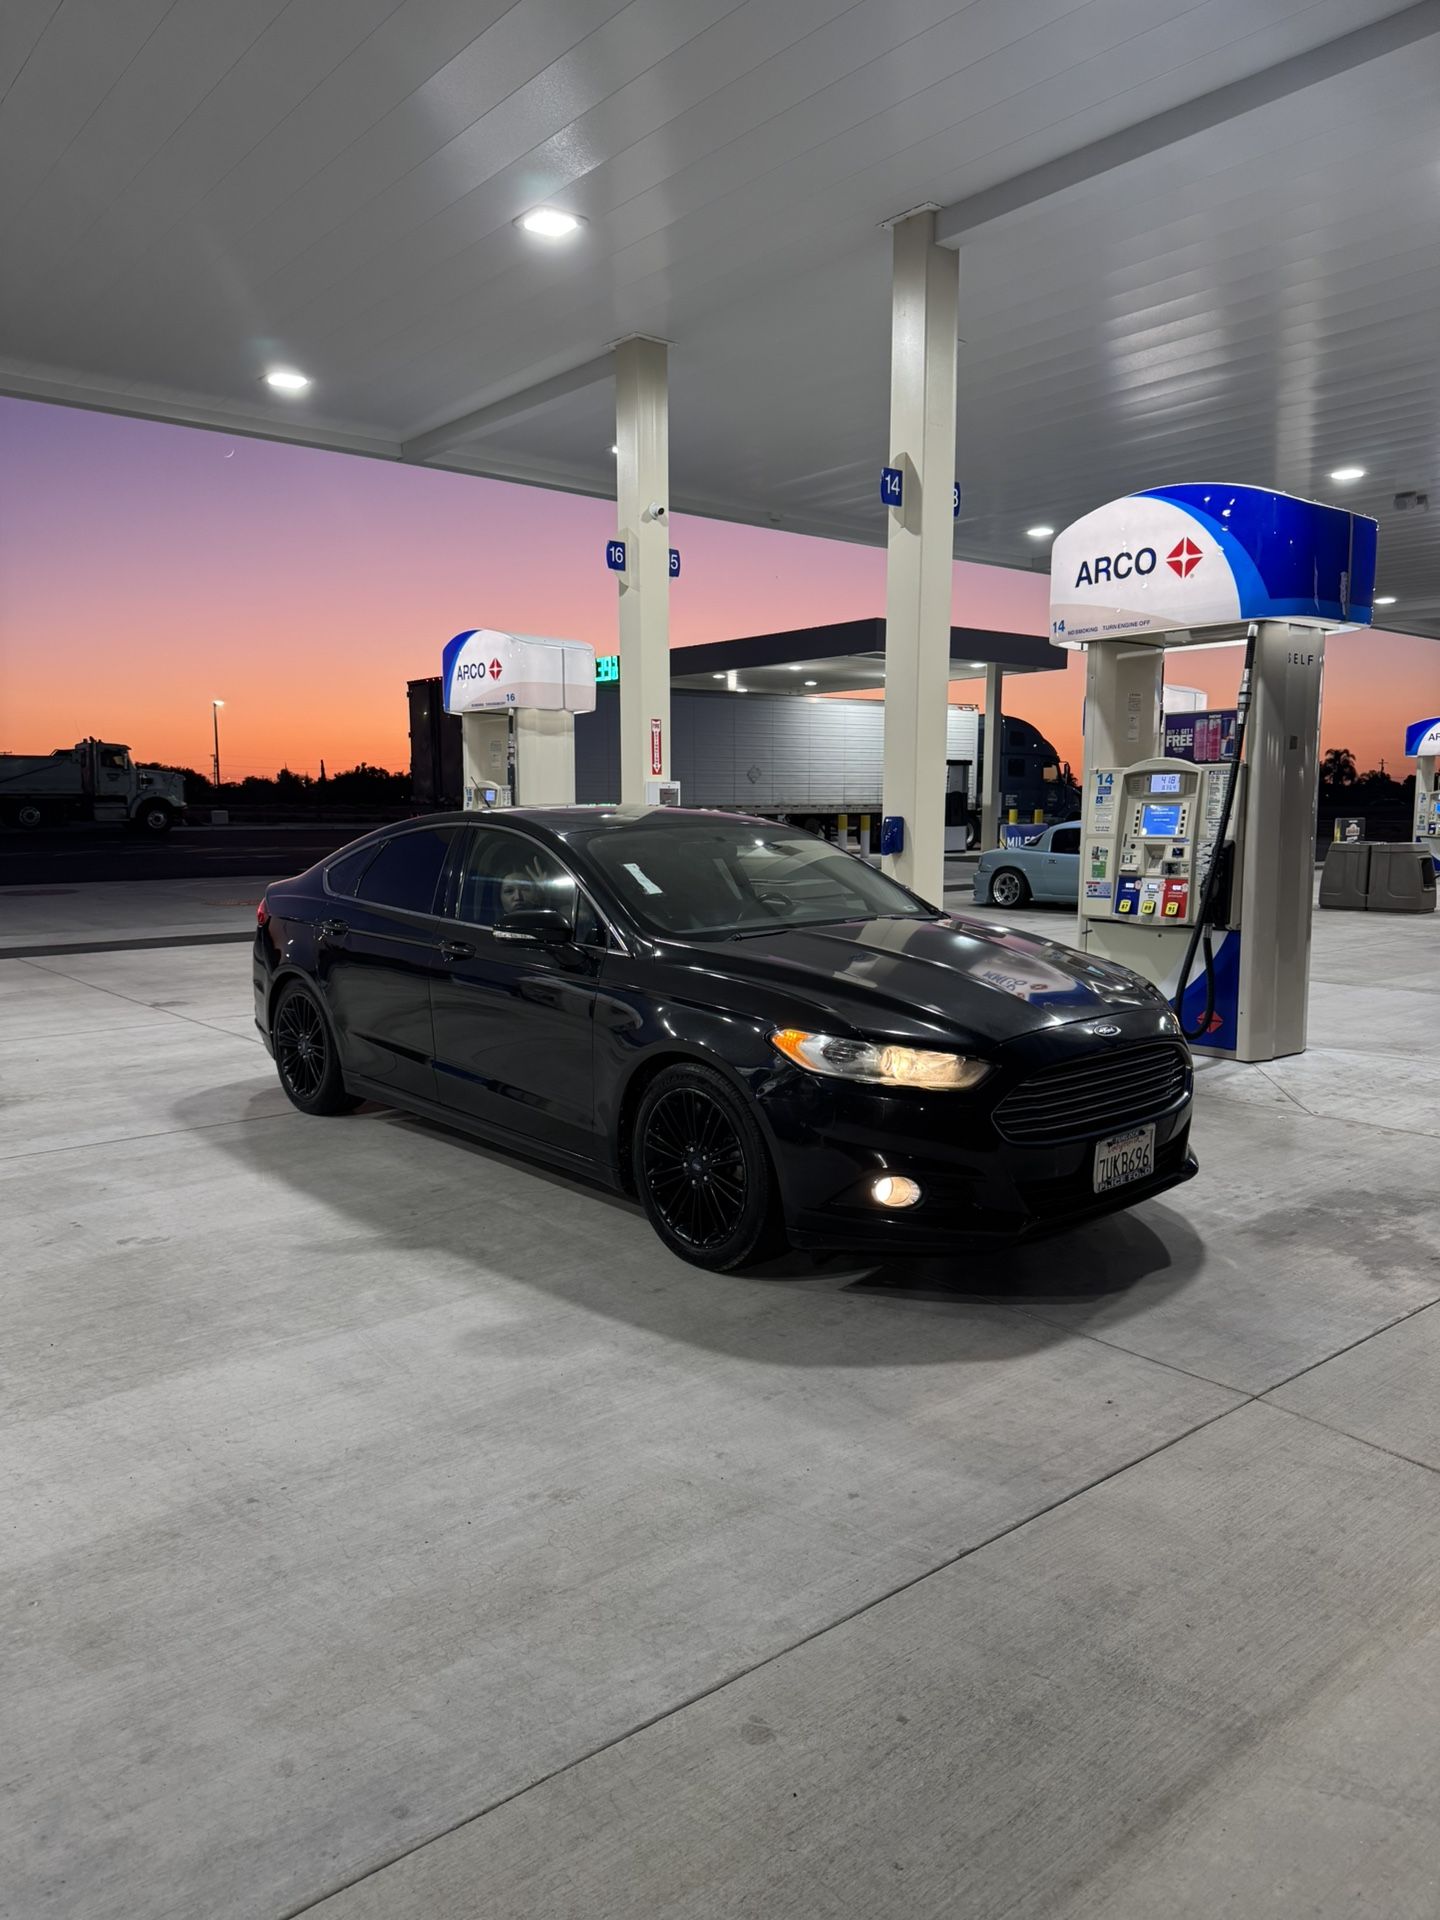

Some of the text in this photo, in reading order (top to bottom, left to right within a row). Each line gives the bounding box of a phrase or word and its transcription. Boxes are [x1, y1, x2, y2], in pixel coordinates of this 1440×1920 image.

[885, 474, 900, 496] 14
[609, 546, 624, 563] 16
[670, 554, 678, 570] 5
[1074, 547, 1157, 588] ARCO
[1052, 620, 1066, 634] 14
[1139, 619, 1151, 627] OFF
[457, 662, 486, 681] ARCO
[506, 693, 515, 702] 16
[1166, 734, 1194, 747] FREE
[1097, 773, 1114, 786] 14
[1099, 1143, 1150, 1182] 7UKB696
